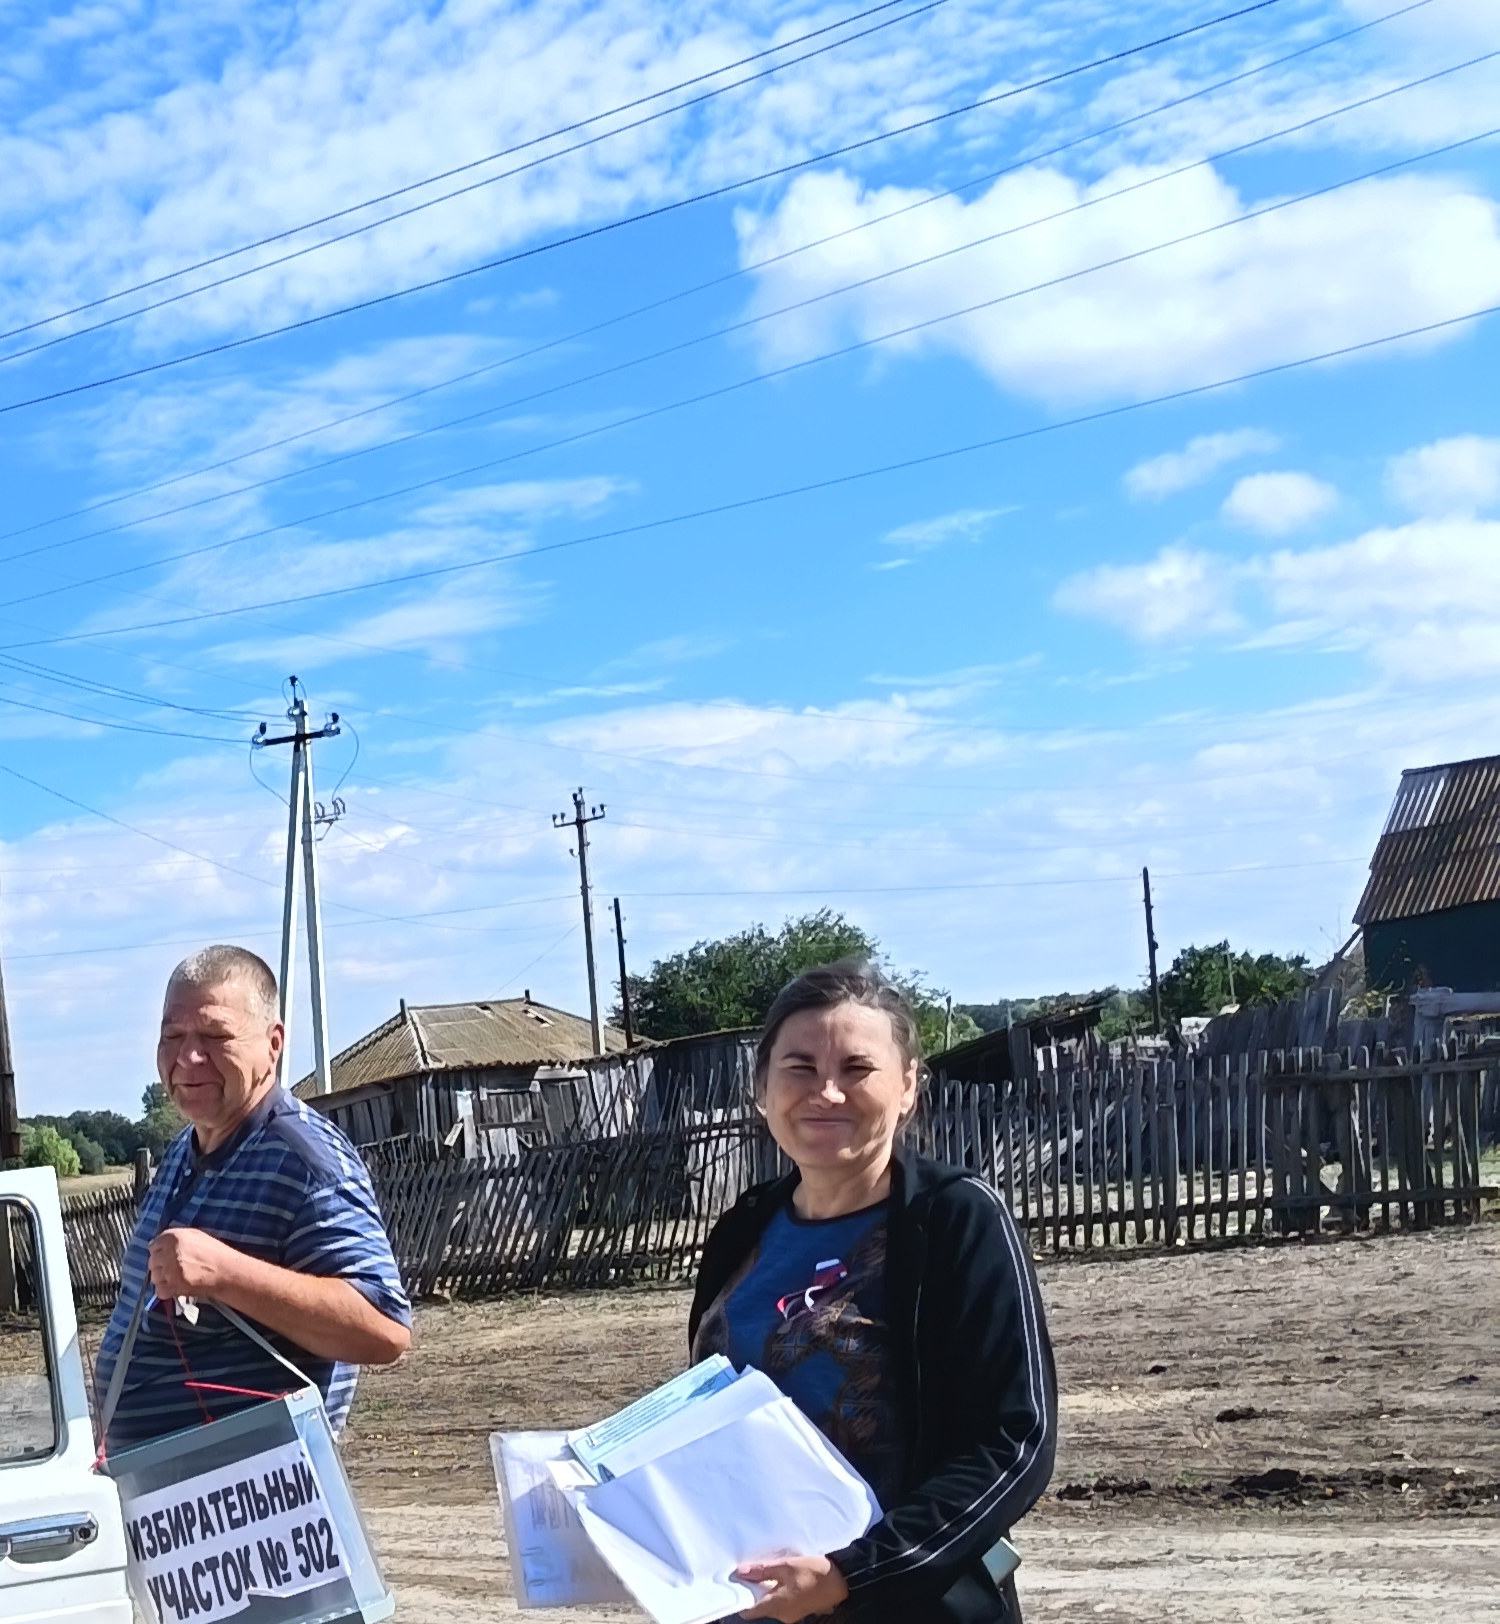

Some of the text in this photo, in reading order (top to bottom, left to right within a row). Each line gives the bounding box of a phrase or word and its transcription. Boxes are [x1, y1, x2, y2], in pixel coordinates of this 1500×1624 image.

[126, 1452, 320, 1562] ИЗБИРАТЕЛЬНЫЙ
[146, 1517, 340, 1624] УЧАСТОК № 502
